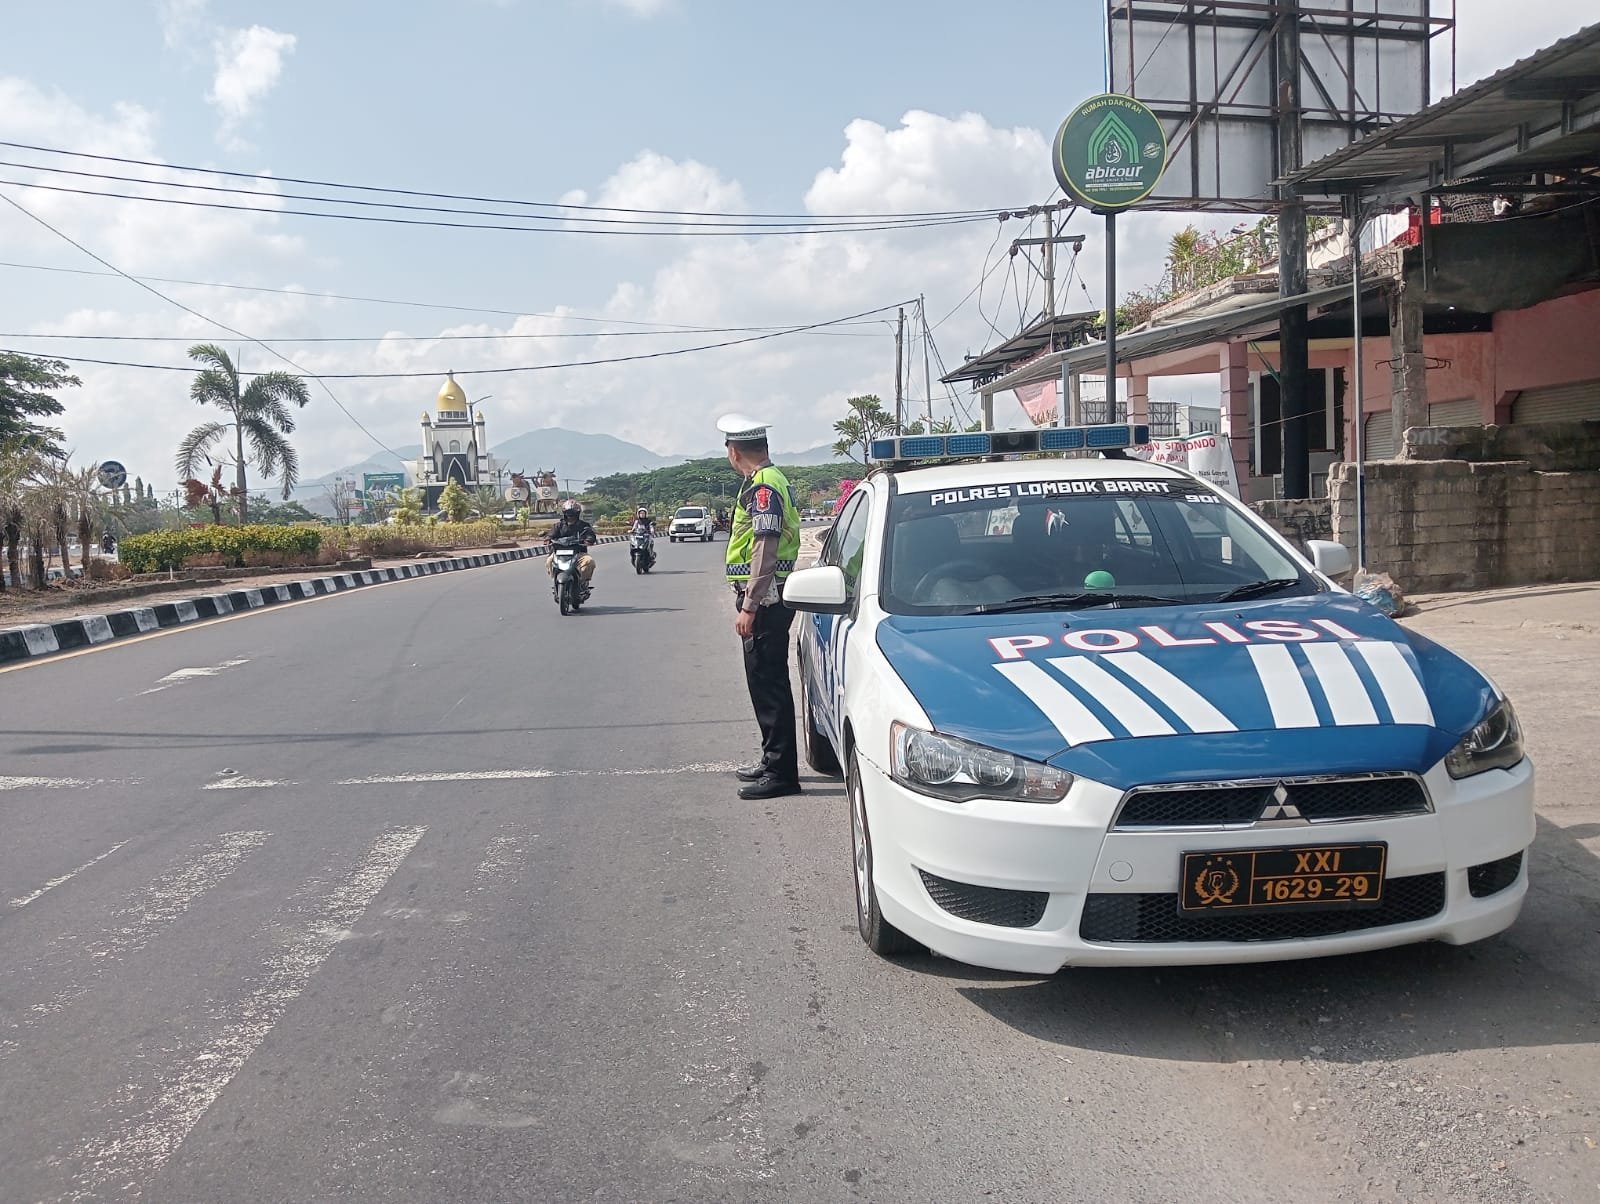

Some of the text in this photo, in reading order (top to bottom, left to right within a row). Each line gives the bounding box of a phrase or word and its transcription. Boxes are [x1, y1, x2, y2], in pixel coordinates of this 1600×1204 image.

[1081, 99, 1142, 116] RUMAH DAKWAH
[1085, 166, 1144, 180] abitour
[930, 481, 1171, 506] POLRES LOMBOK BARAT
[988, 618, 1364, 661] POLISI
[1294, 851, 1340, 873] XXI
[1262, 876, 1369, 901] 1629-29
